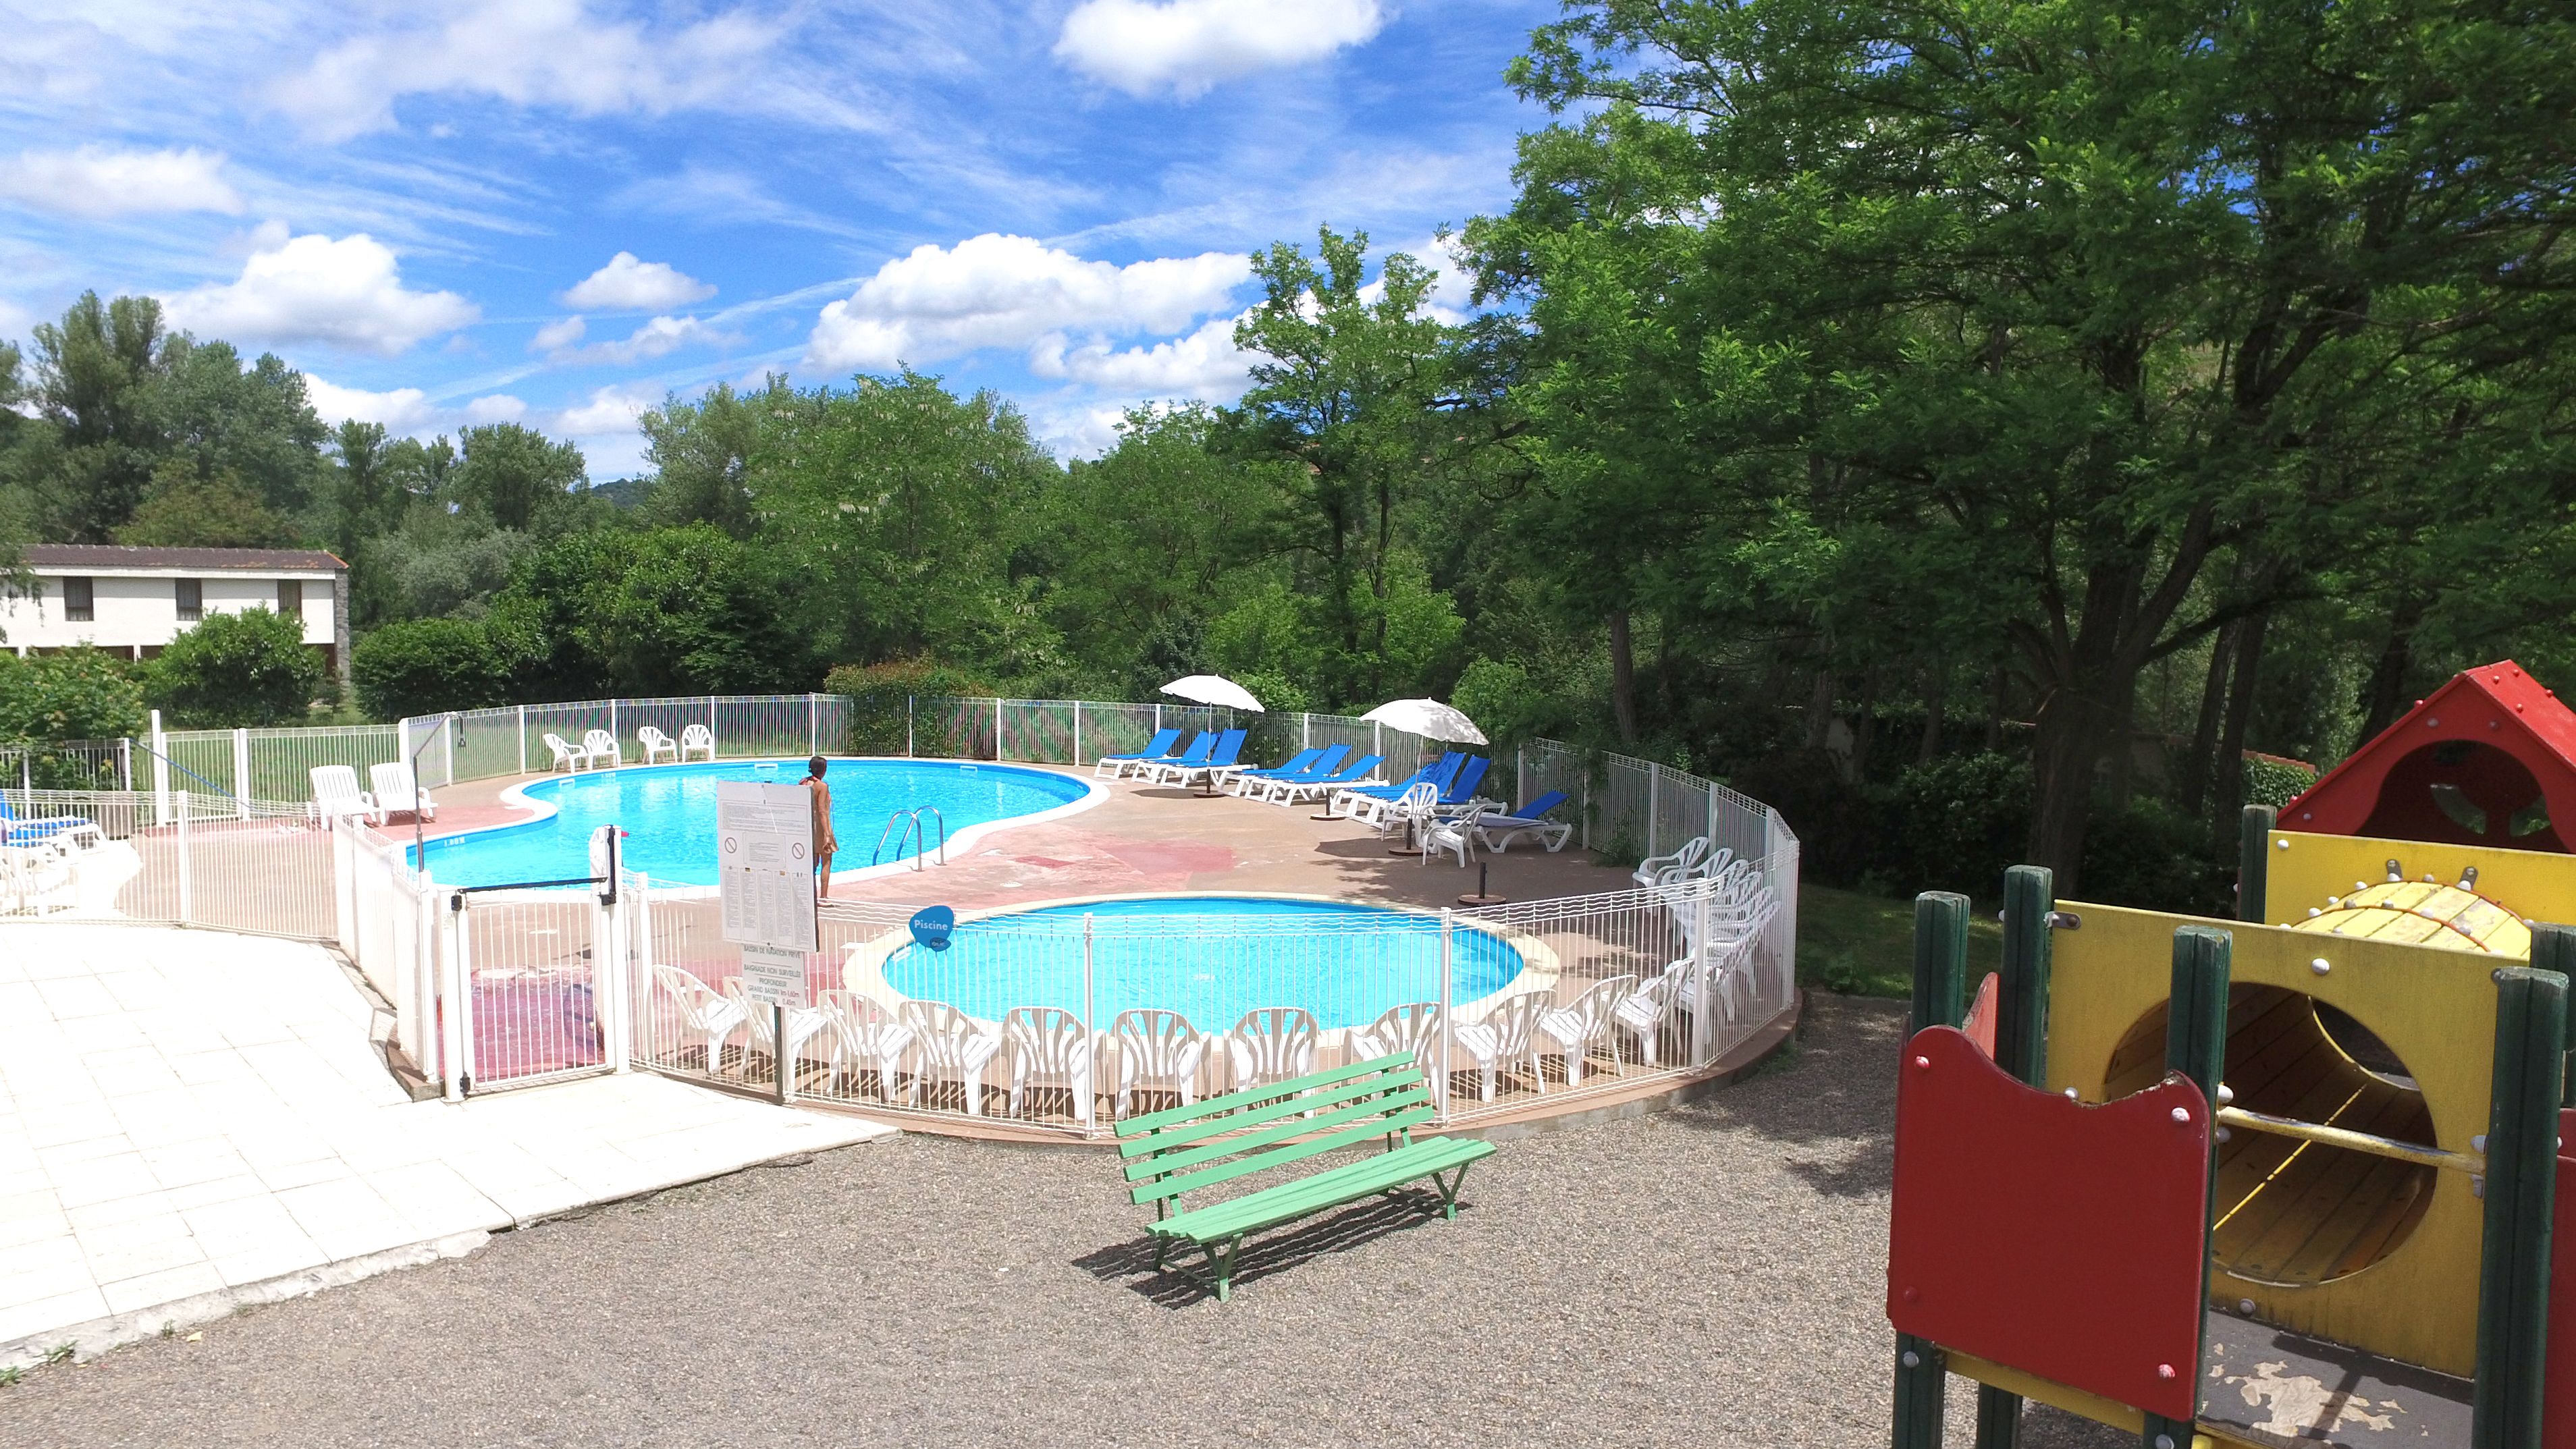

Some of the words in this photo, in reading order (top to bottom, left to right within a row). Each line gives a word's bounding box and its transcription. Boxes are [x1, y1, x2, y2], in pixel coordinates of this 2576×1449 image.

[914, 919, 948, 931] Piscine
[744, 964, 766, 973] BAIGNADE
[759, 977, 787, 987] PROFONDEUR
[747, 985, 763, 993] GRAND
[764, 987, 779, 995] BASSIN
[763, 995, 778, 1004] BASSIN
